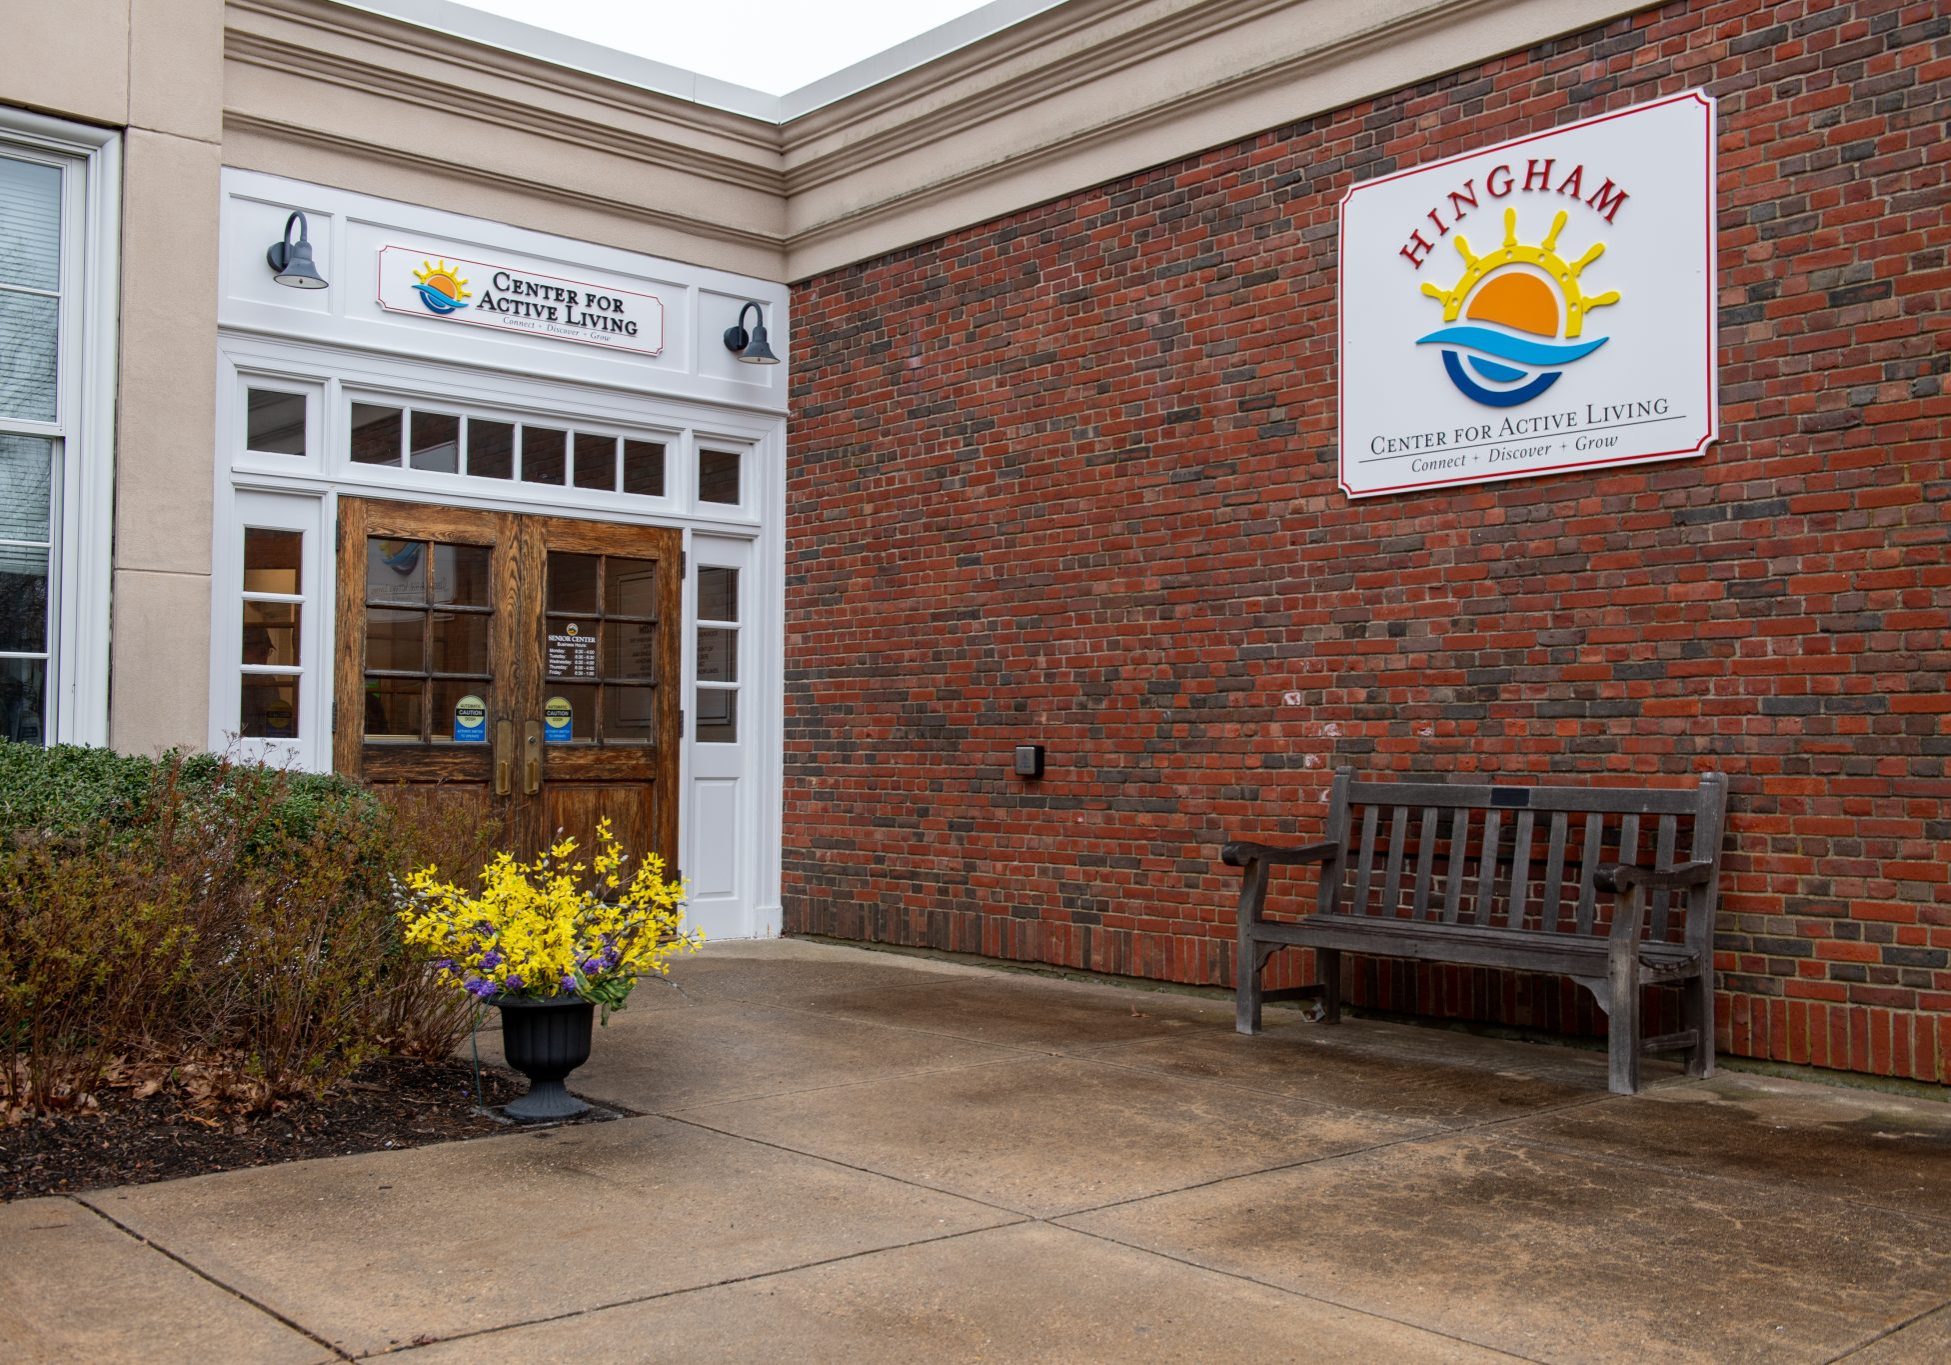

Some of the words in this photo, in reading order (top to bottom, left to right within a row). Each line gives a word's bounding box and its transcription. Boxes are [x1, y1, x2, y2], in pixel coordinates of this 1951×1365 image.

[1399, 158, 1630, 269] HINGHAM
[493, 272, 579, 305] CENTER
[476, 290, 558, 321] ACTIVE
[564, 305, 638, 335] LIVING
[502, 315, 536, 330] Connect
[546, 323, 580, 338] Discover
[589, 331, 612, 343] Grow
[1370, 425, 1448, 456] CENTER
[1497, 411, 1579, 437] ACTIVE
[1585, 397, 1670, 426] LIVING
[1411, 454, 1467, 473] Connect
[1487, 443, 1552, 464] Discover
[1574, 434, 1619, 453] Grow
